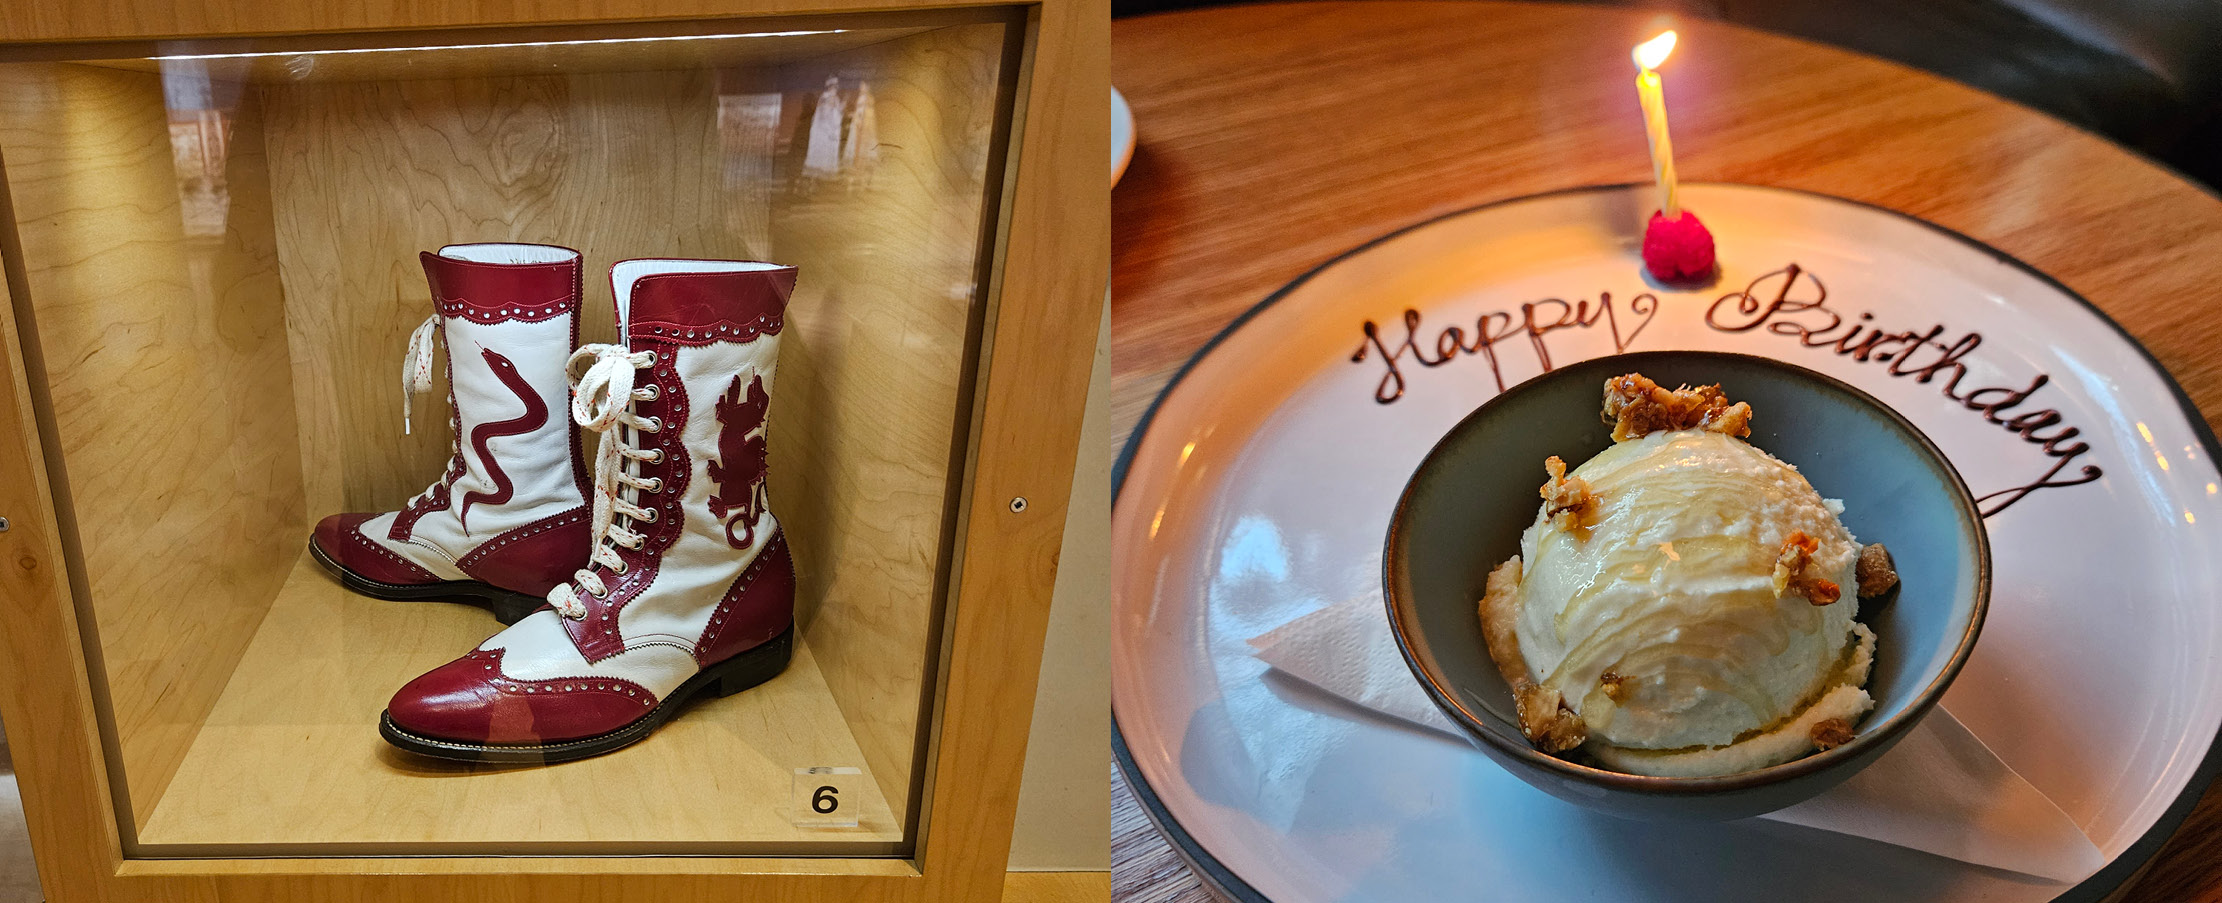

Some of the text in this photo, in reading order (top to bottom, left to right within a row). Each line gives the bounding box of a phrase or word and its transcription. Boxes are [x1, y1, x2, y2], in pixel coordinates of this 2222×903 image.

[1350, 263, 2103, 518] Happy Birthday
[811, 785, 839, 814] 6
